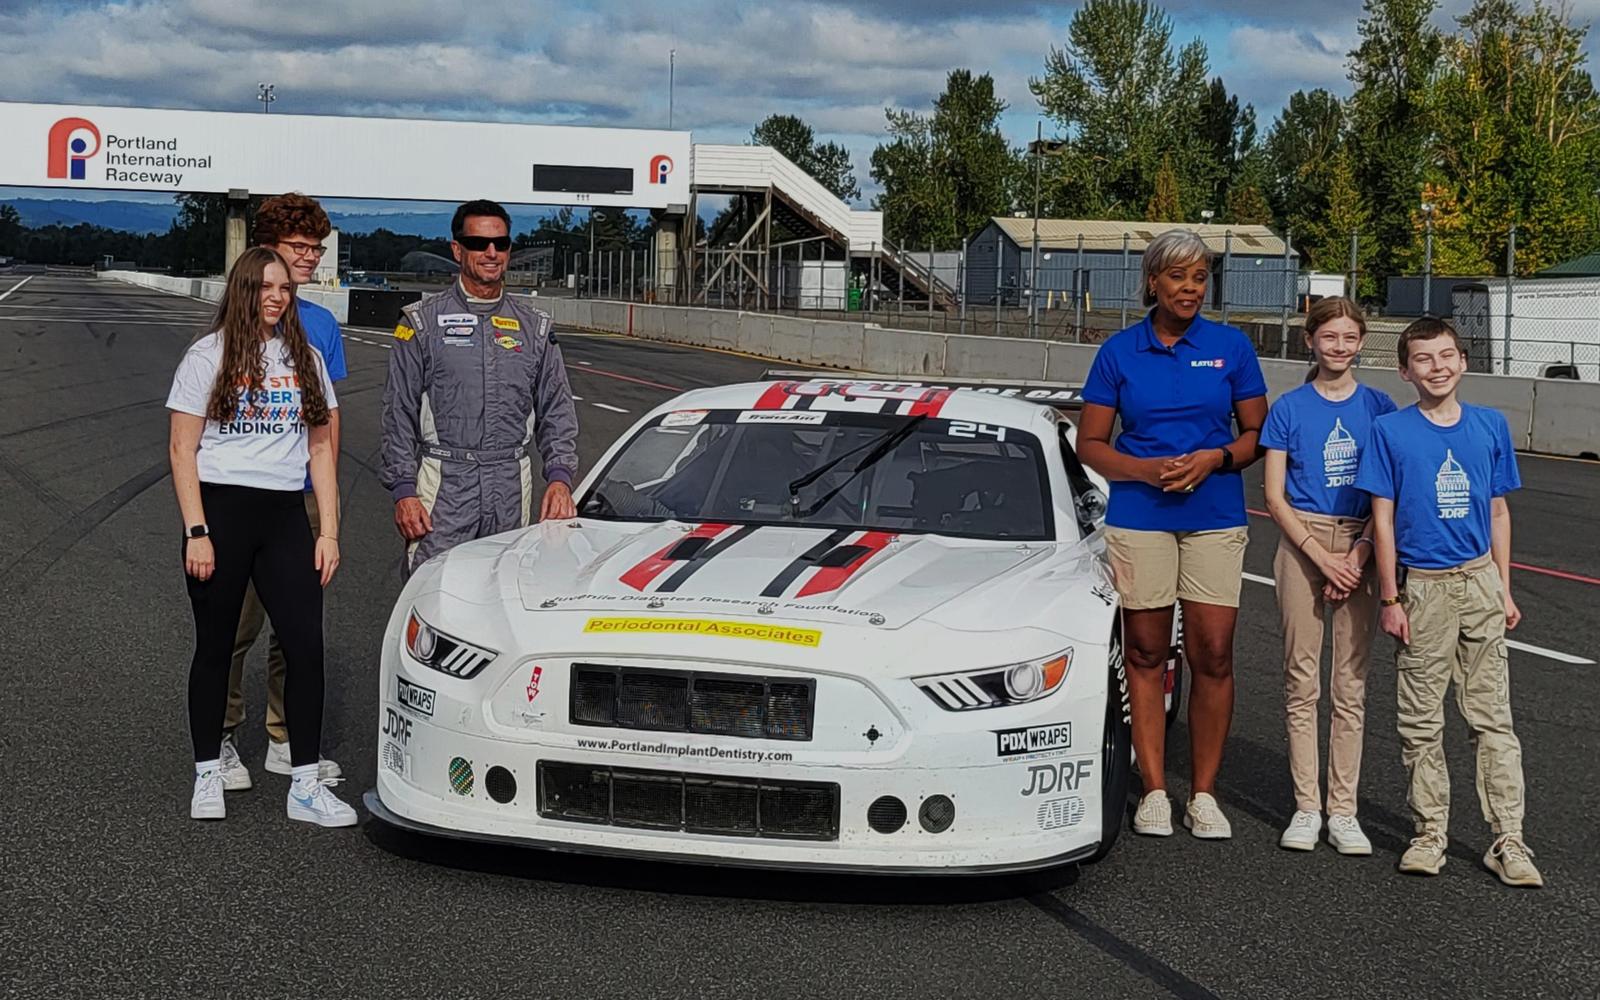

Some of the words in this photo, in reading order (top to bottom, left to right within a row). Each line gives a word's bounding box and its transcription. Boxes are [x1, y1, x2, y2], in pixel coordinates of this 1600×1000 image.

[106, 135, 177, 150] Portland
[106, 152, 211, 168] International
[106, 168, 183, 186] Raceway
[219, 423, 284, 434] ENDING
[948, 420, 1006, 441] 24
[1438, 507, 1470, 519] JDRF
[551, 594, 617, 602] Juvenile
[700, 596, 778, 608] Research
[783, 602, 881, 617] Foundation
[589, 620, 700, 632] Periodontal
[705, 623, 815, 643] Associates
[529, 673, 539, 696] TOW
[409, 684, 433, 710] WRAPS
[382, 707, 413, 746] JDRF
[577, 739, 793, 763] www.PortlandImplantDentistry.com
[1000, 731, 1027, 752] PDX
[1029, 727, 1068, 751] WRAPS
[1020, 760, 1093, 796] JDRF
